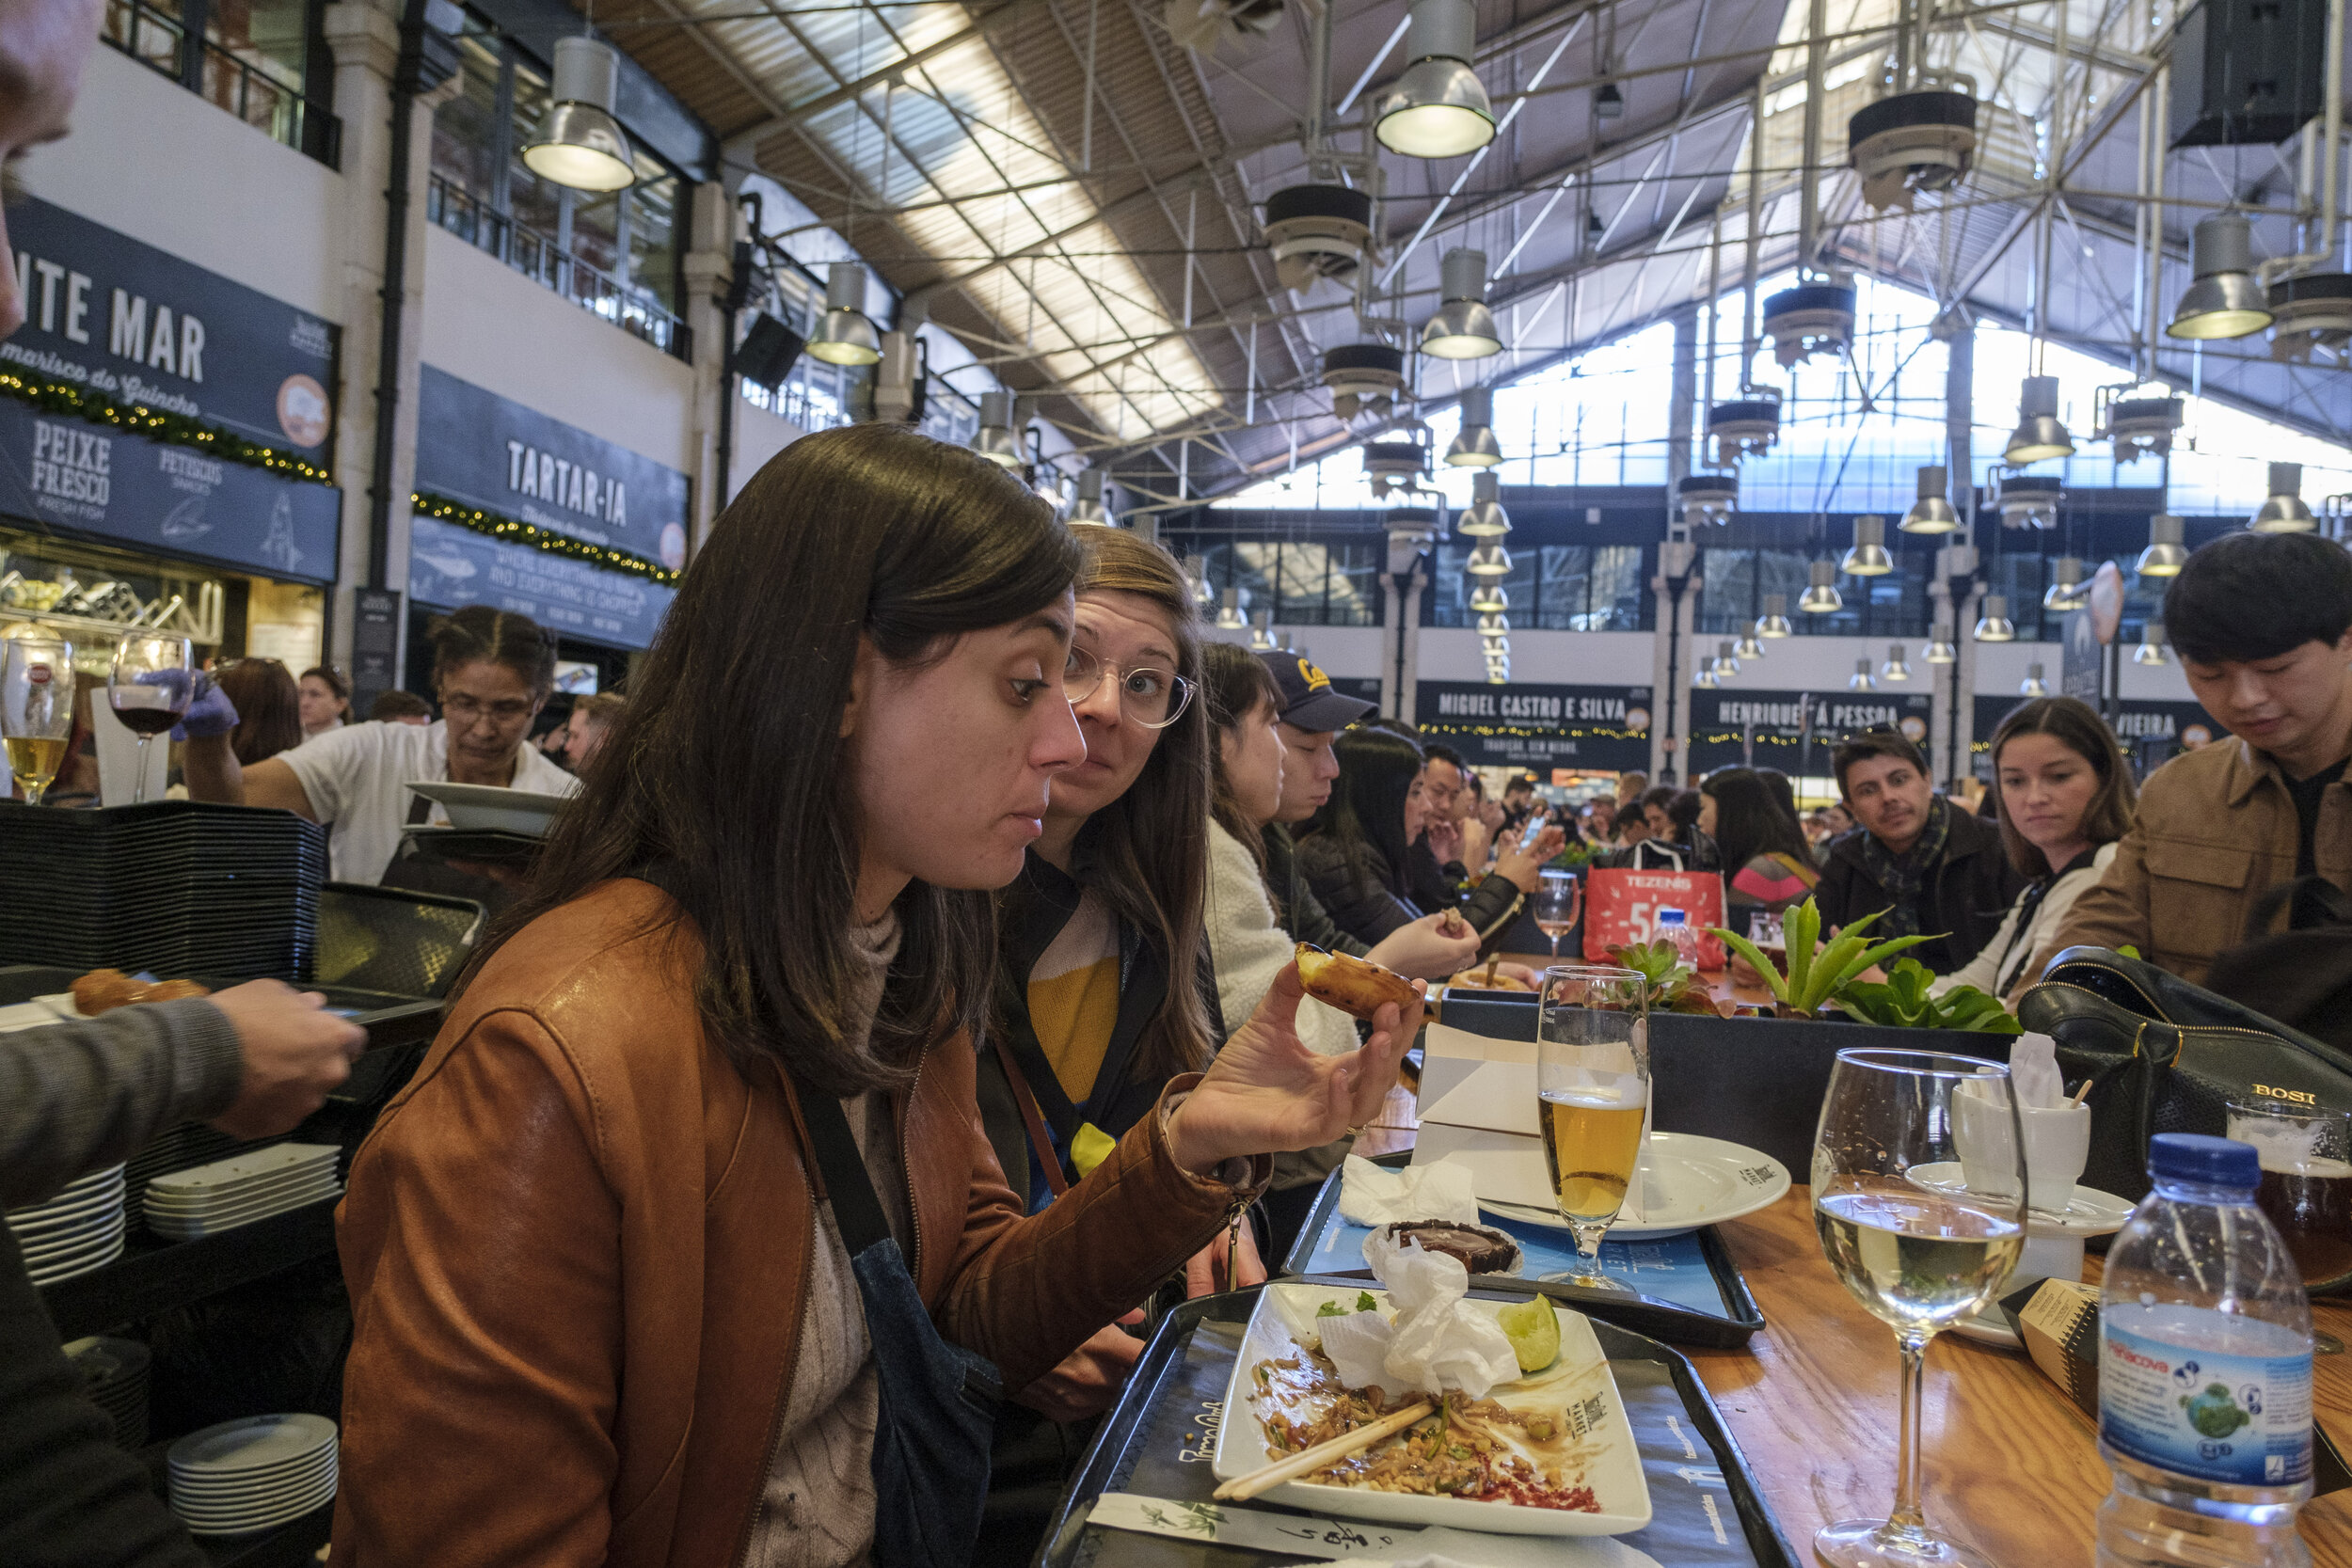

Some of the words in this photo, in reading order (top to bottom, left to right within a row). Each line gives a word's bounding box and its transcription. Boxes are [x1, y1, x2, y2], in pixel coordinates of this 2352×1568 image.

[110, 287, 206, 383] MAR
[34, 420, 112, 475] PEIXE
[32, 458, 111, 507] FRESCO
[1438, 693, 1496, 716] MIGUEL
[1501, 695, 1561, 719] CASTRO
[1565, 697, 1575, 720] E
[1579, 698, 1626, 721] SILVA
[1833, 705, 1899, 728] PESSOA
[1626, 875, 1692, 892] TEZENIS
[2251, 1084, 2316, 1105] BOSI
[1571, 1402, 1588, 1436] MARKET
